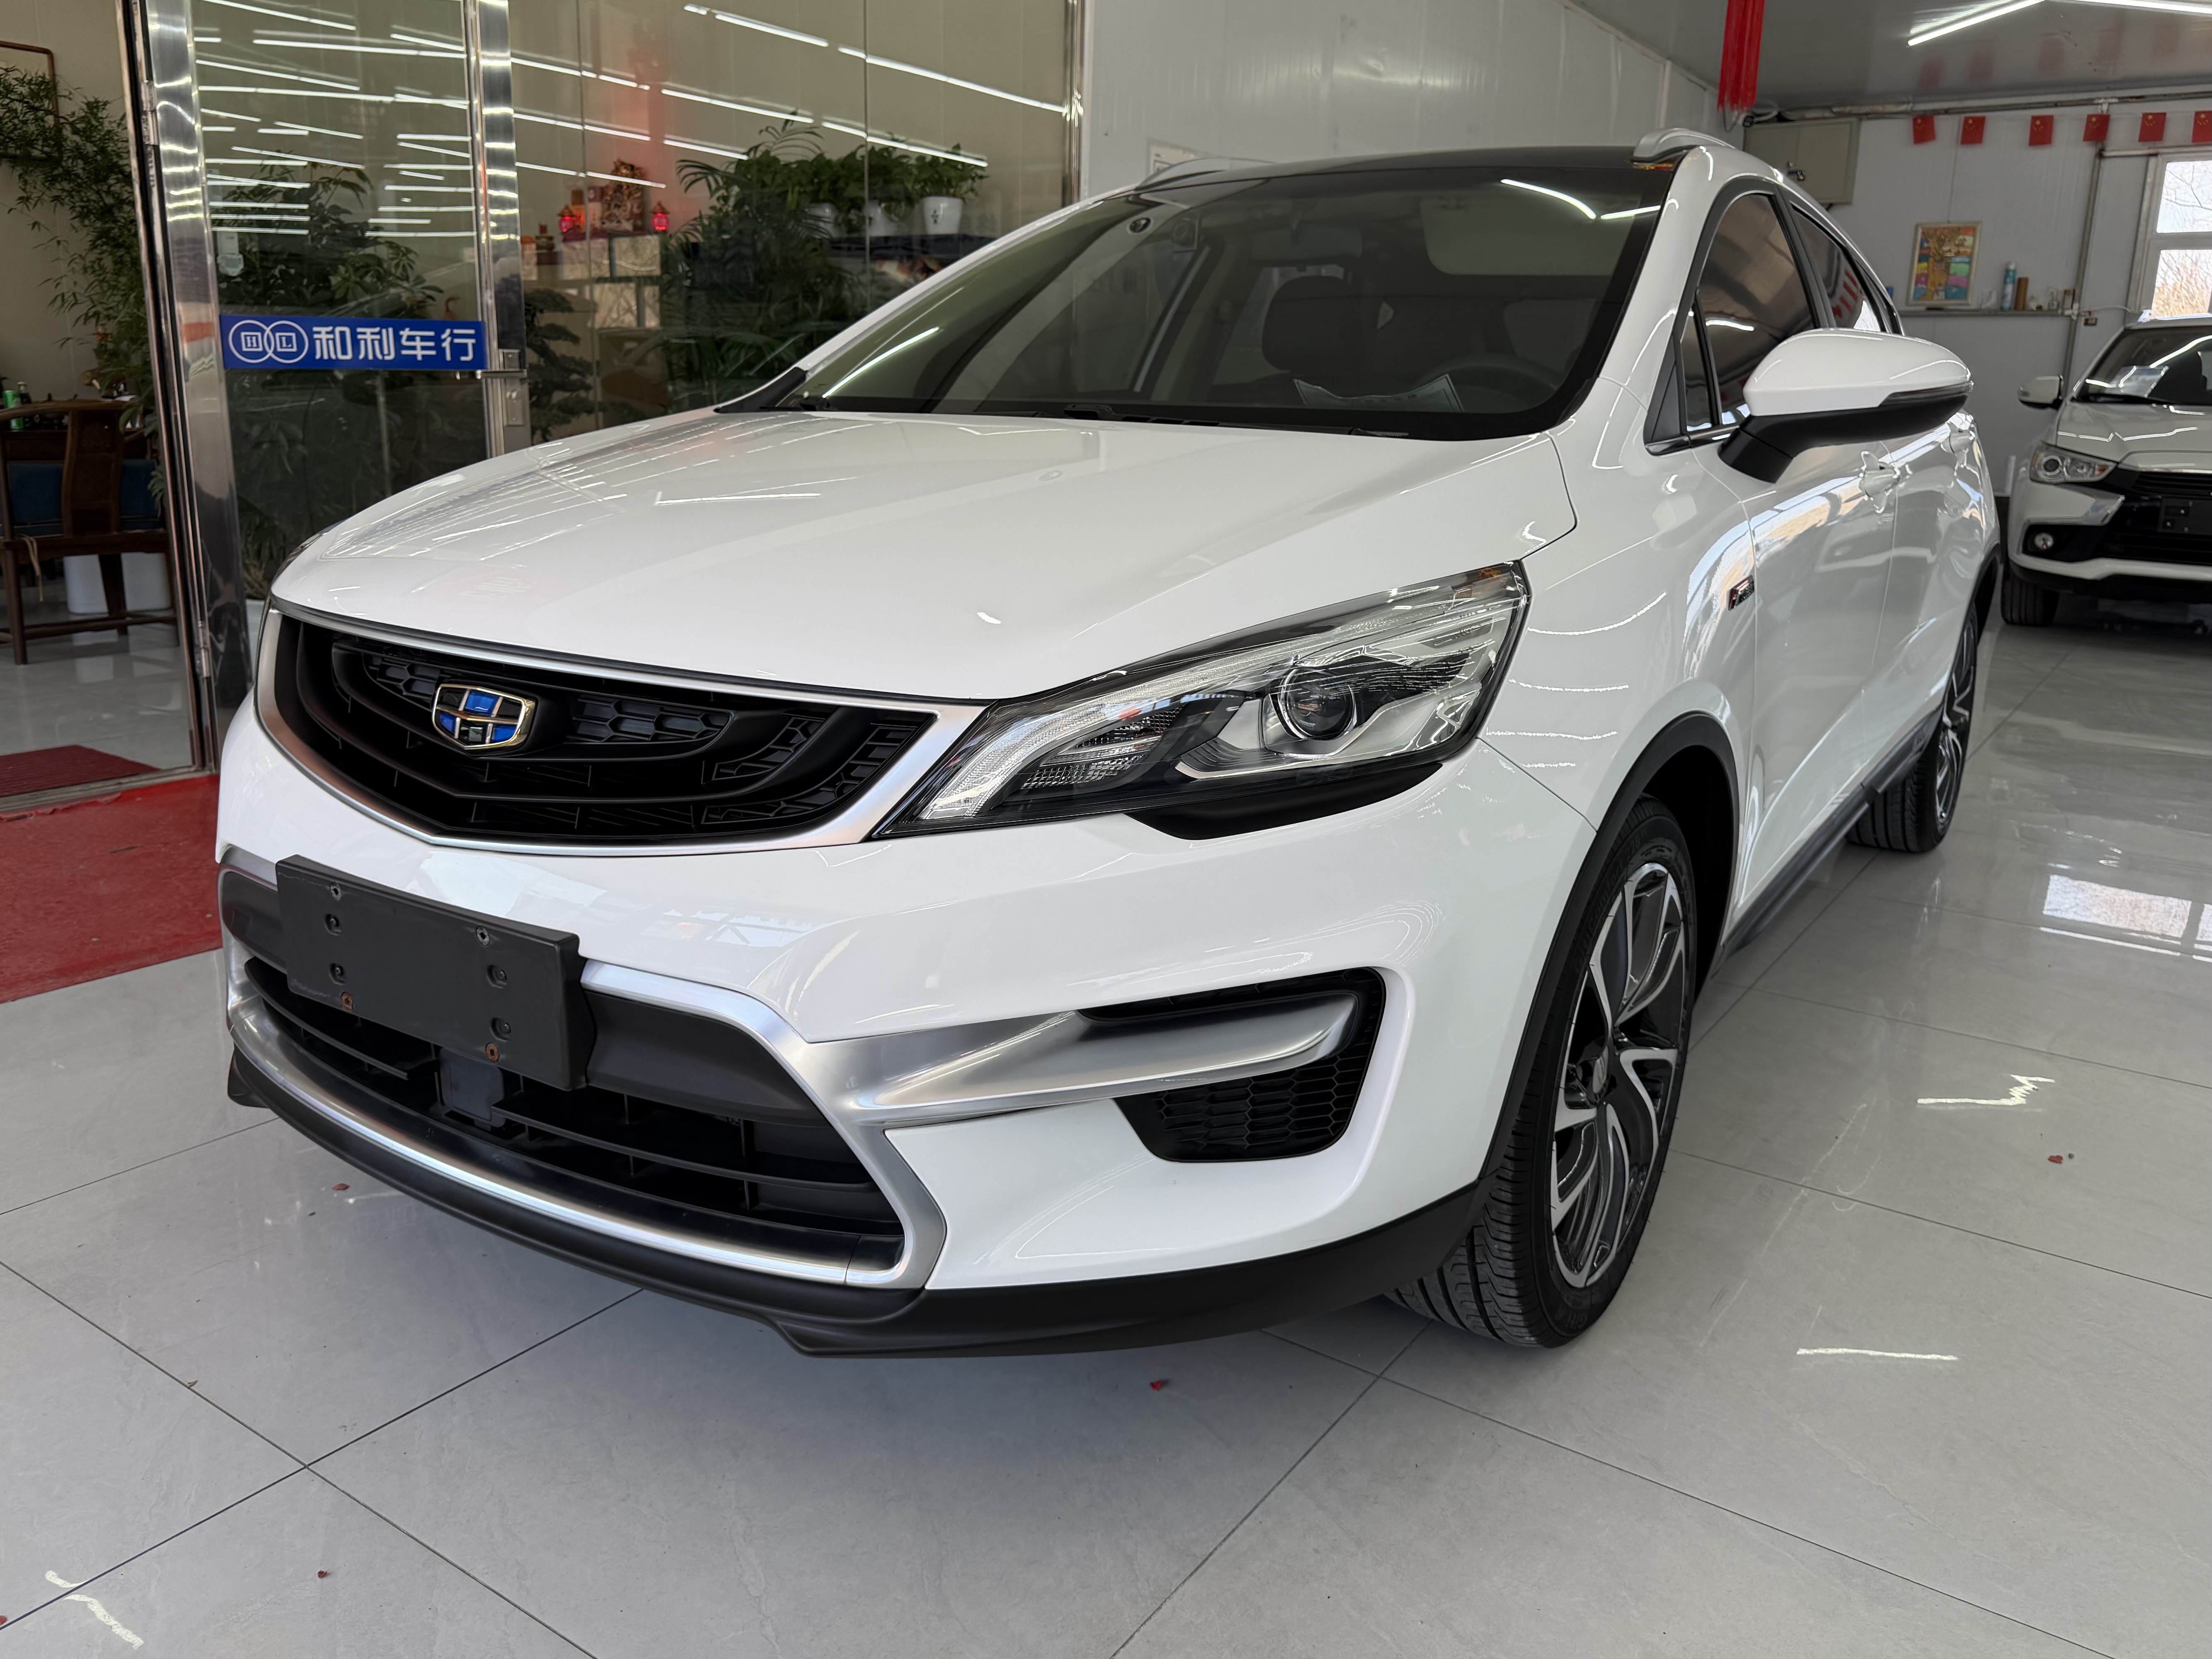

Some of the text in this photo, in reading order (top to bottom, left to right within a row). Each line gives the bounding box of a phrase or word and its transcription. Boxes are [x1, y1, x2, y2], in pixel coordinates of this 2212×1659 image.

[246, 336, 292, 348] H L
[312, 326, 476, 361] 和利车行
[1624, 834, 1640, 859] 228
